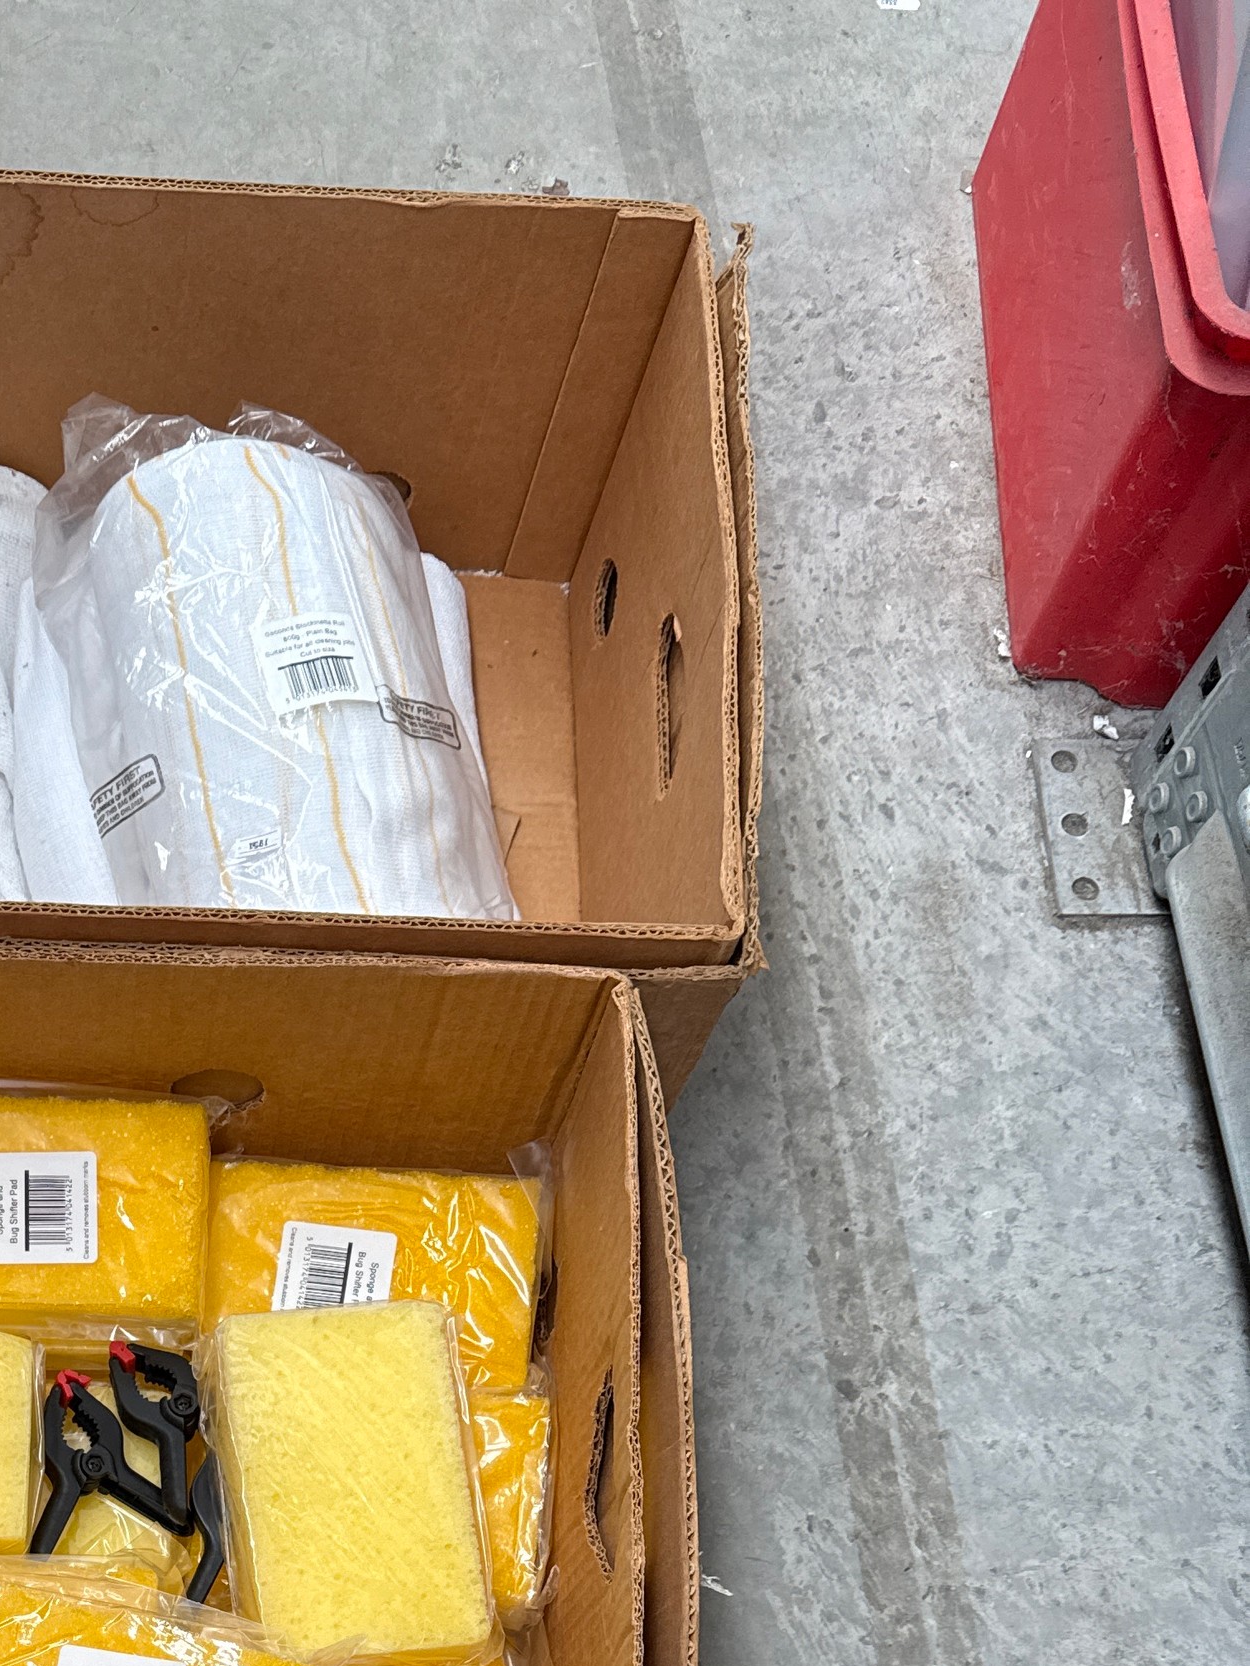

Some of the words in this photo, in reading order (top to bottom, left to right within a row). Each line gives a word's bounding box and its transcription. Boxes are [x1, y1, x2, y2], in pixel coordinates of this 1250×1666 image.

[91, 786, 113, 810] FETY
[115, 766, 140, 790] FIRST
[10, 1227, 19, 1243] Bug
[355, 1251, 366, 1268] Bug
[352, 1270, 363, 1297] Shifter
[366, 1262, 379, 1293] Sponge
